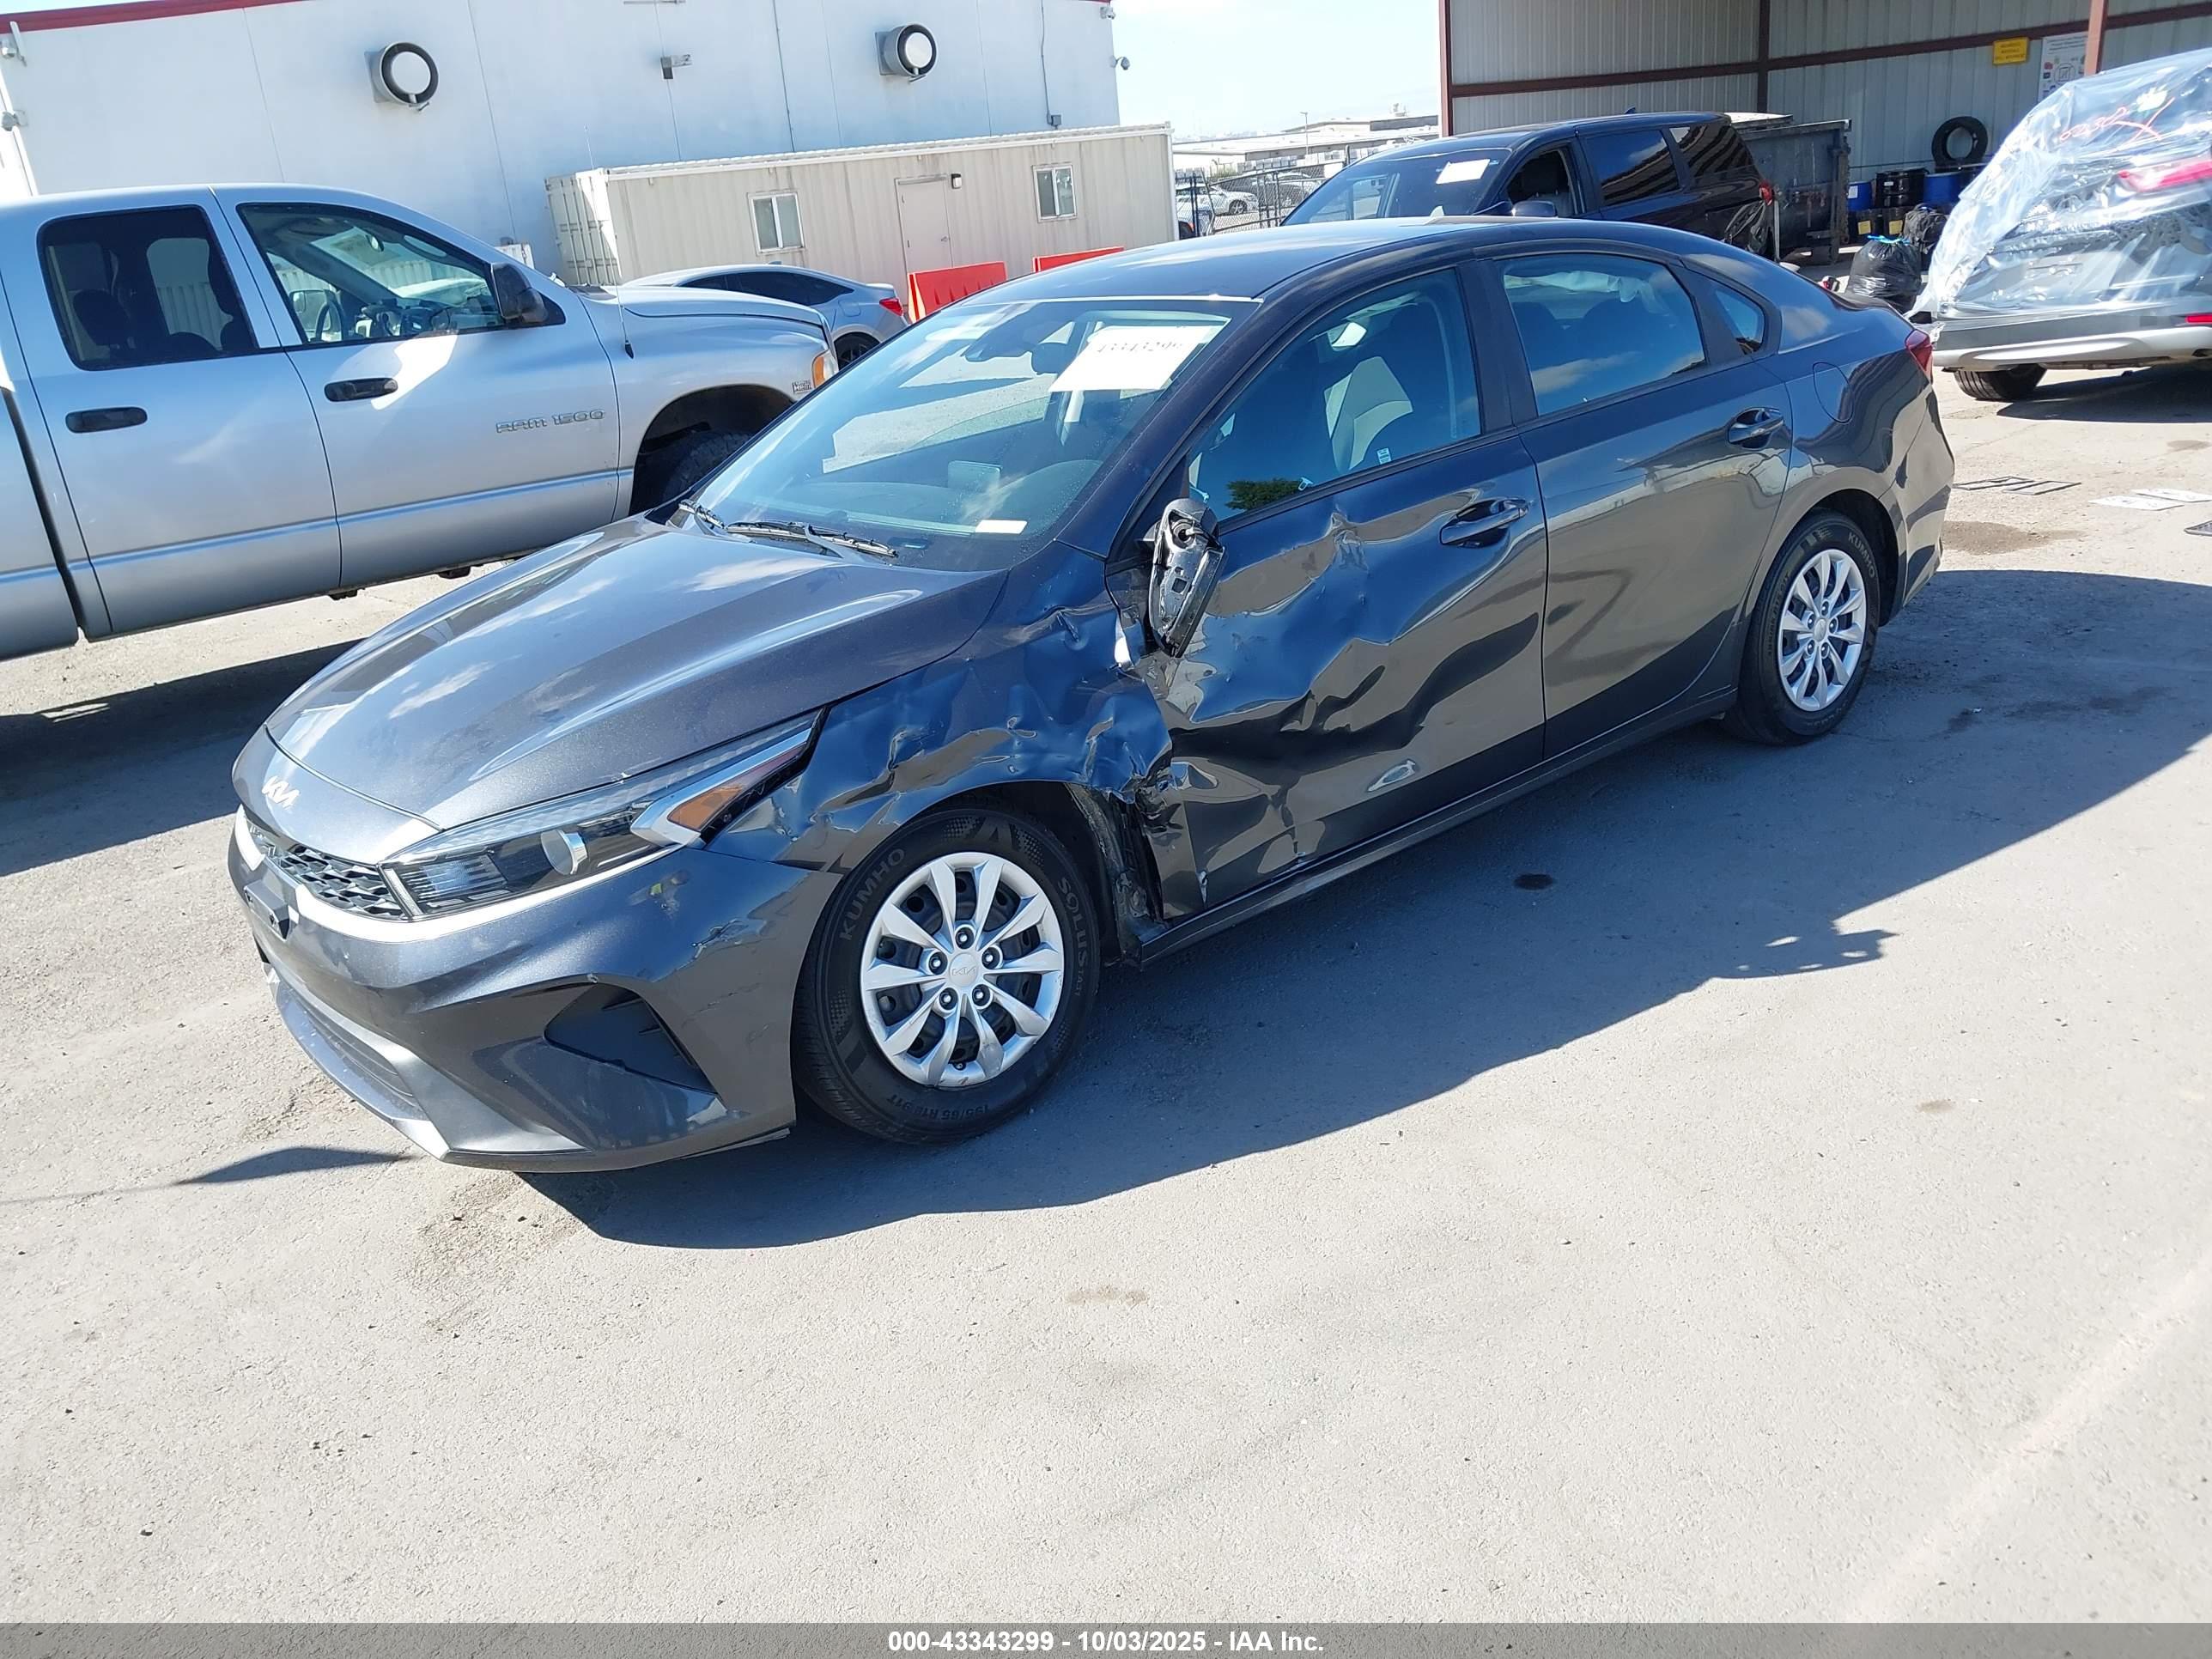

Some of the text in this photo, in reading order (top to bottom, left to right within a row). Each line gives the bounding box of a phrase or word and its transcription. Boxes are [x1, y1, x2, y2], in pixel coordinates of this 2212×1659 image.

[495, 409, 605, 434] RAM 1500
[261, 775, 301, 810] KIA
[839, 848, 905, 941] KUMHO
[1057, 877, 1088, 967] SOLUS
[951, 965, 976, 976] KIA
